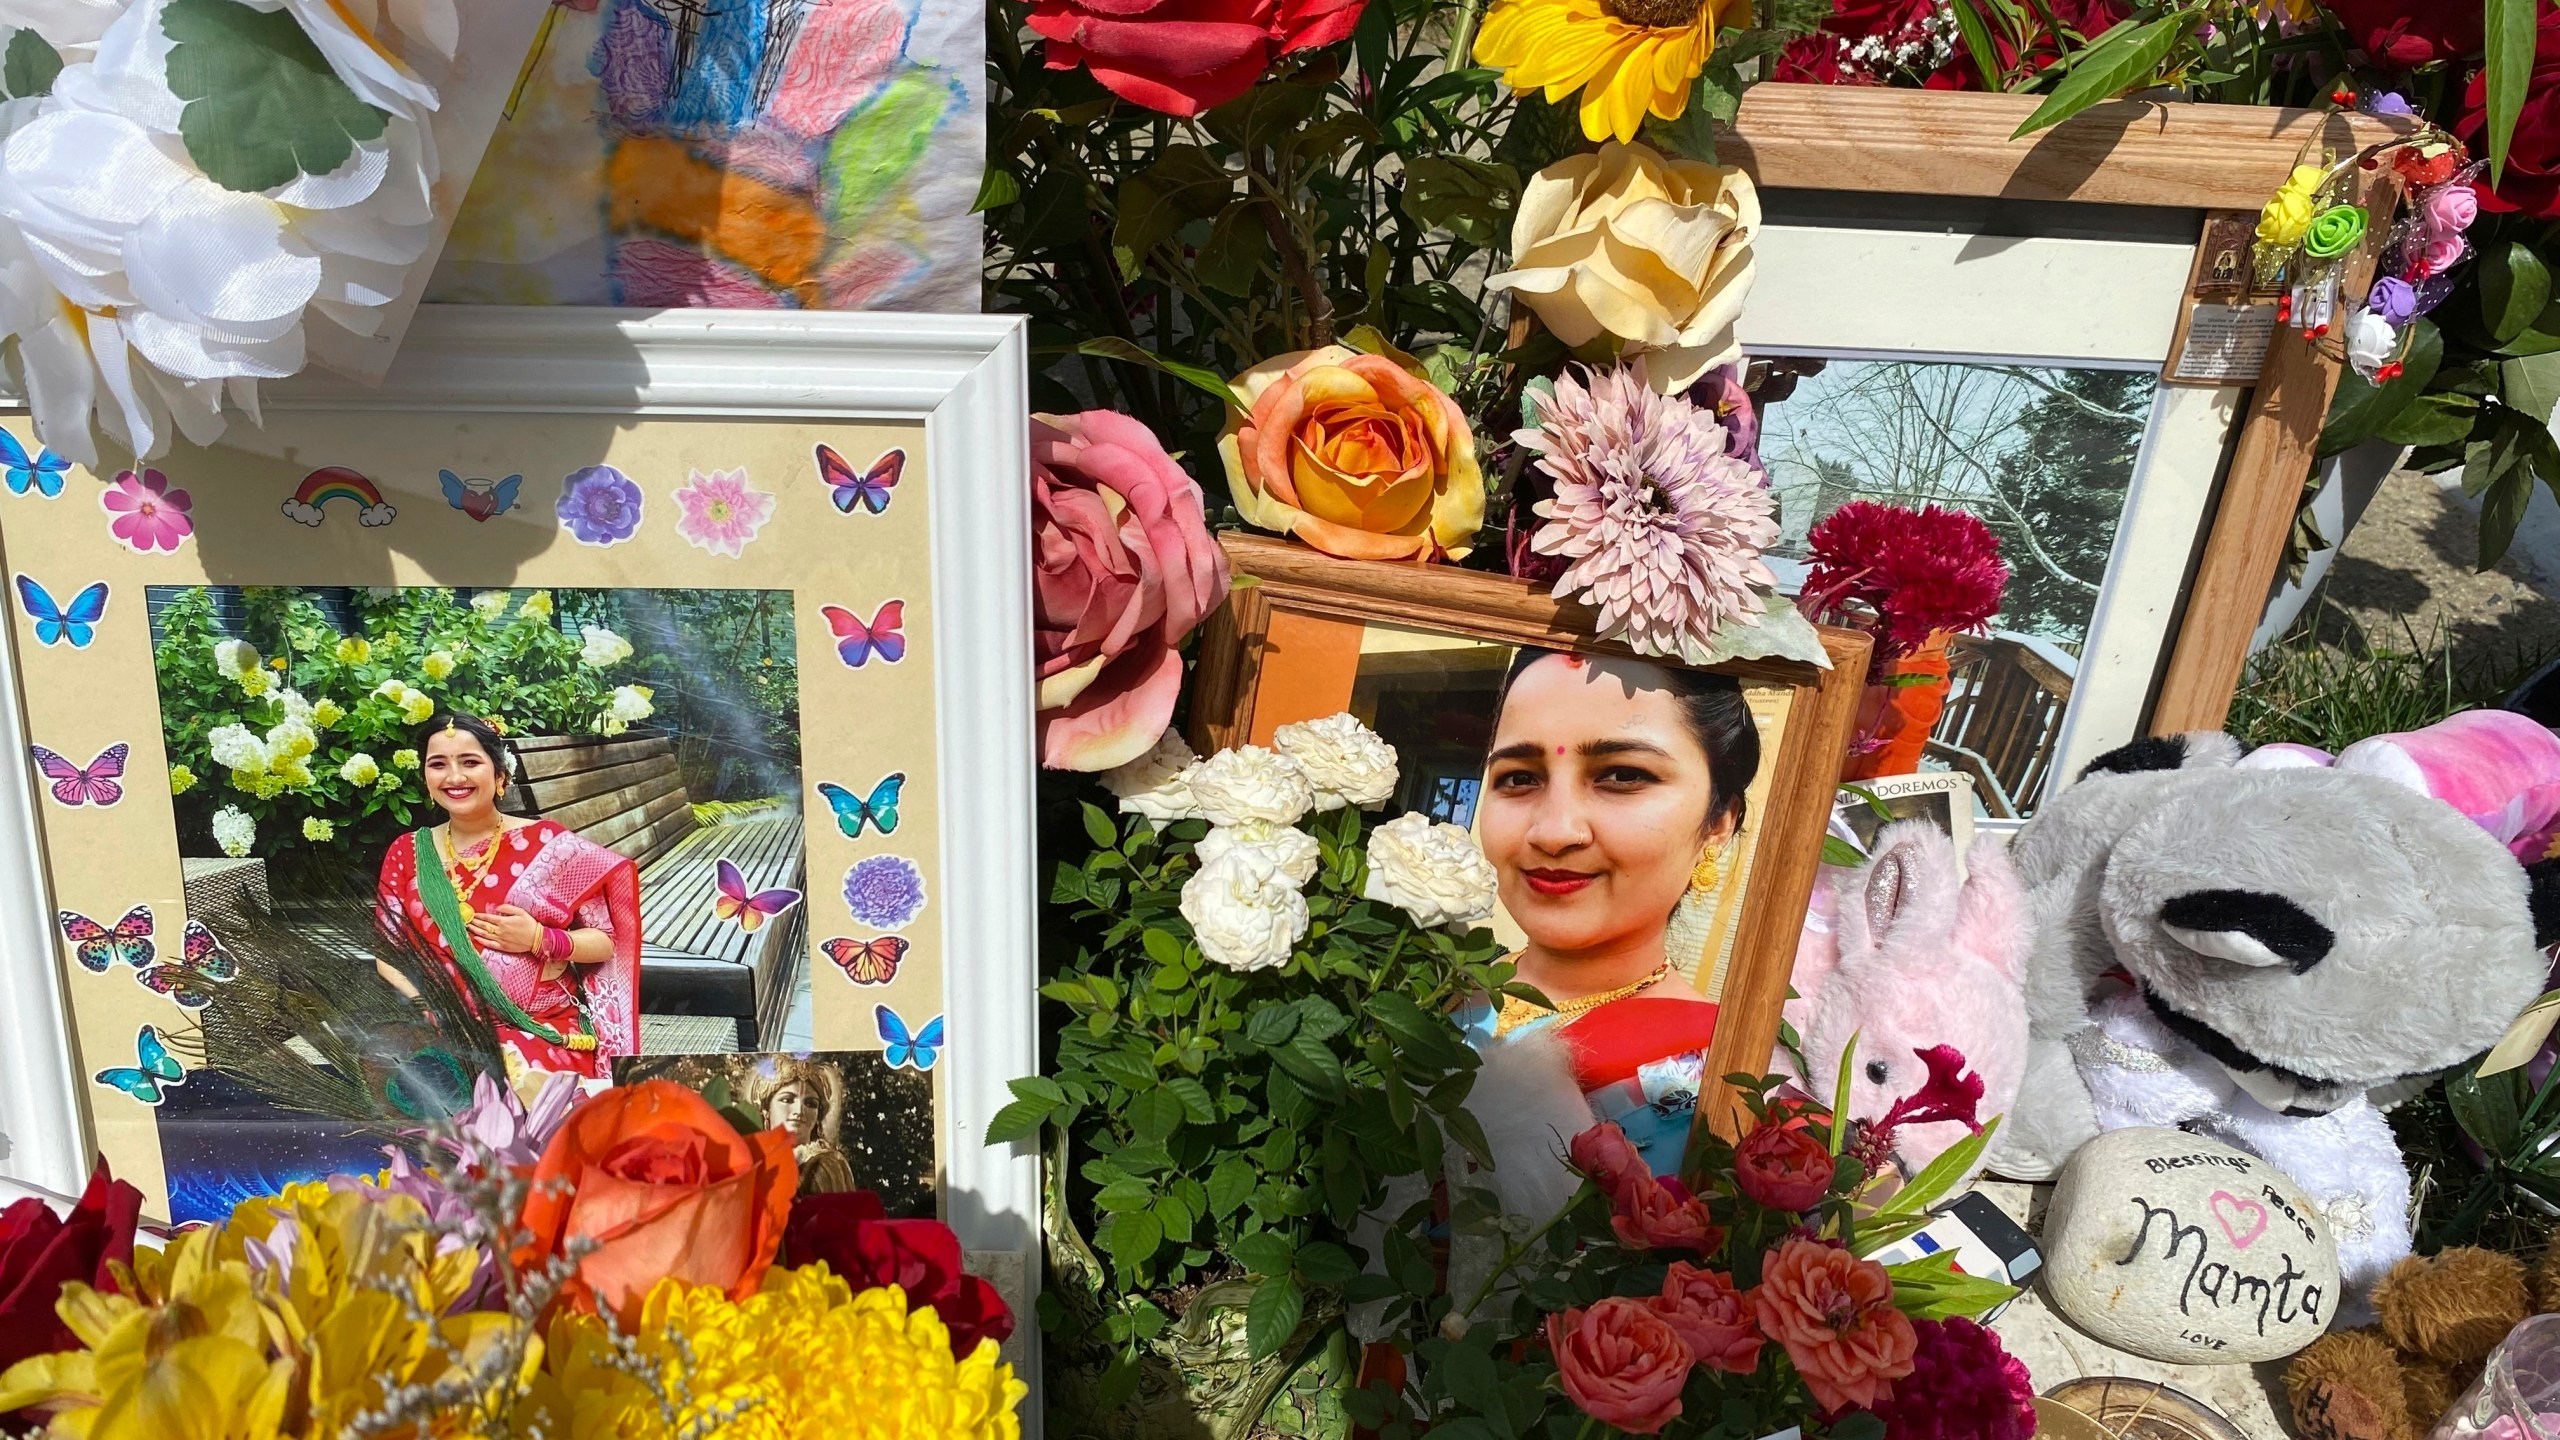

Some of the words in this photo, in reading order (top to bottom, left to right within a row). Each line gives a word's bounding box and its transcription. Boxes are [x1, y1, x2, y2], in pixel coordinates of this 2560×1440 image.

[1868, 779, 1957, 798] ADOREMOS
[2145, 1152, 2252, 1174] Blessings
[2261, 1184, 2316, 1245] Peace
[2115, 1196, 2323, 1338] Mamta
[2179, 1329, 2227, 1351] LOVE
